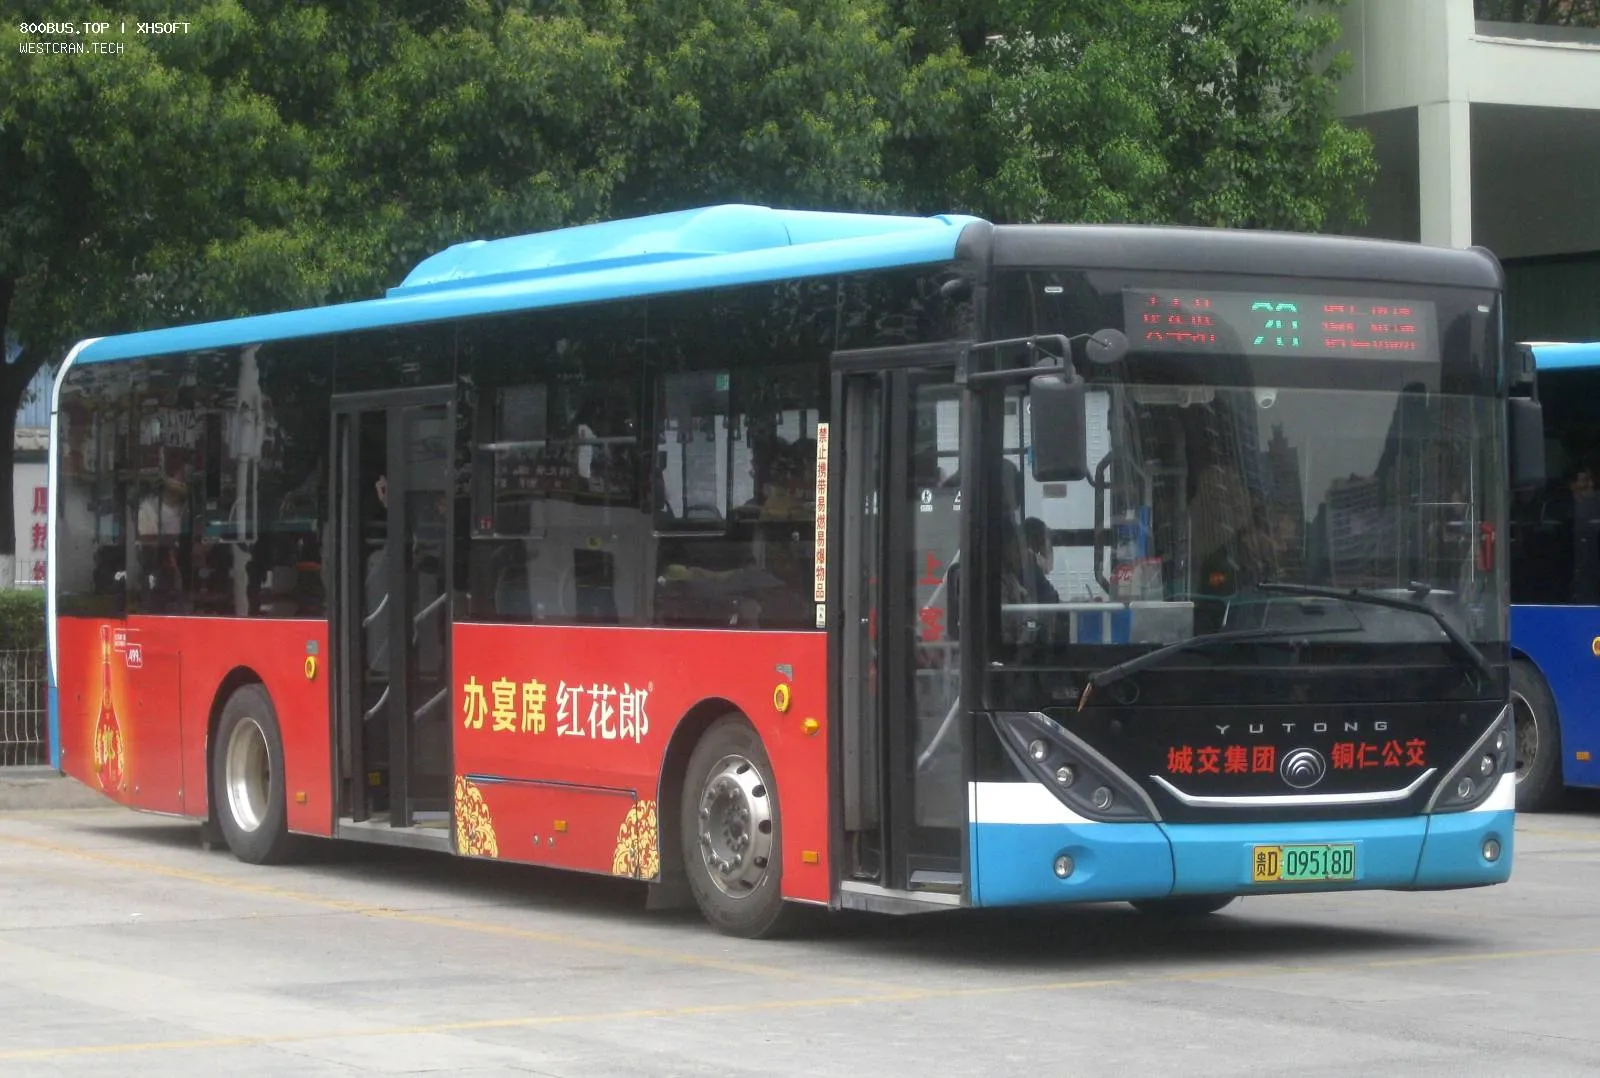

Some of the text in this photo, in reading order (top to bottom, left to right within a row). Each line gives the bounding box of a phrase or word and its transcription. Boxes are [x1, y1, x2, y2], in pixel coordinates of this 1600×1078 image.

[463, 675, 649, 743] 办宴席 红花郎
[1215, 721, 1388, 735] YUTONG
[1167, 738, 1426, 774] 城交集团 铜仁公交
